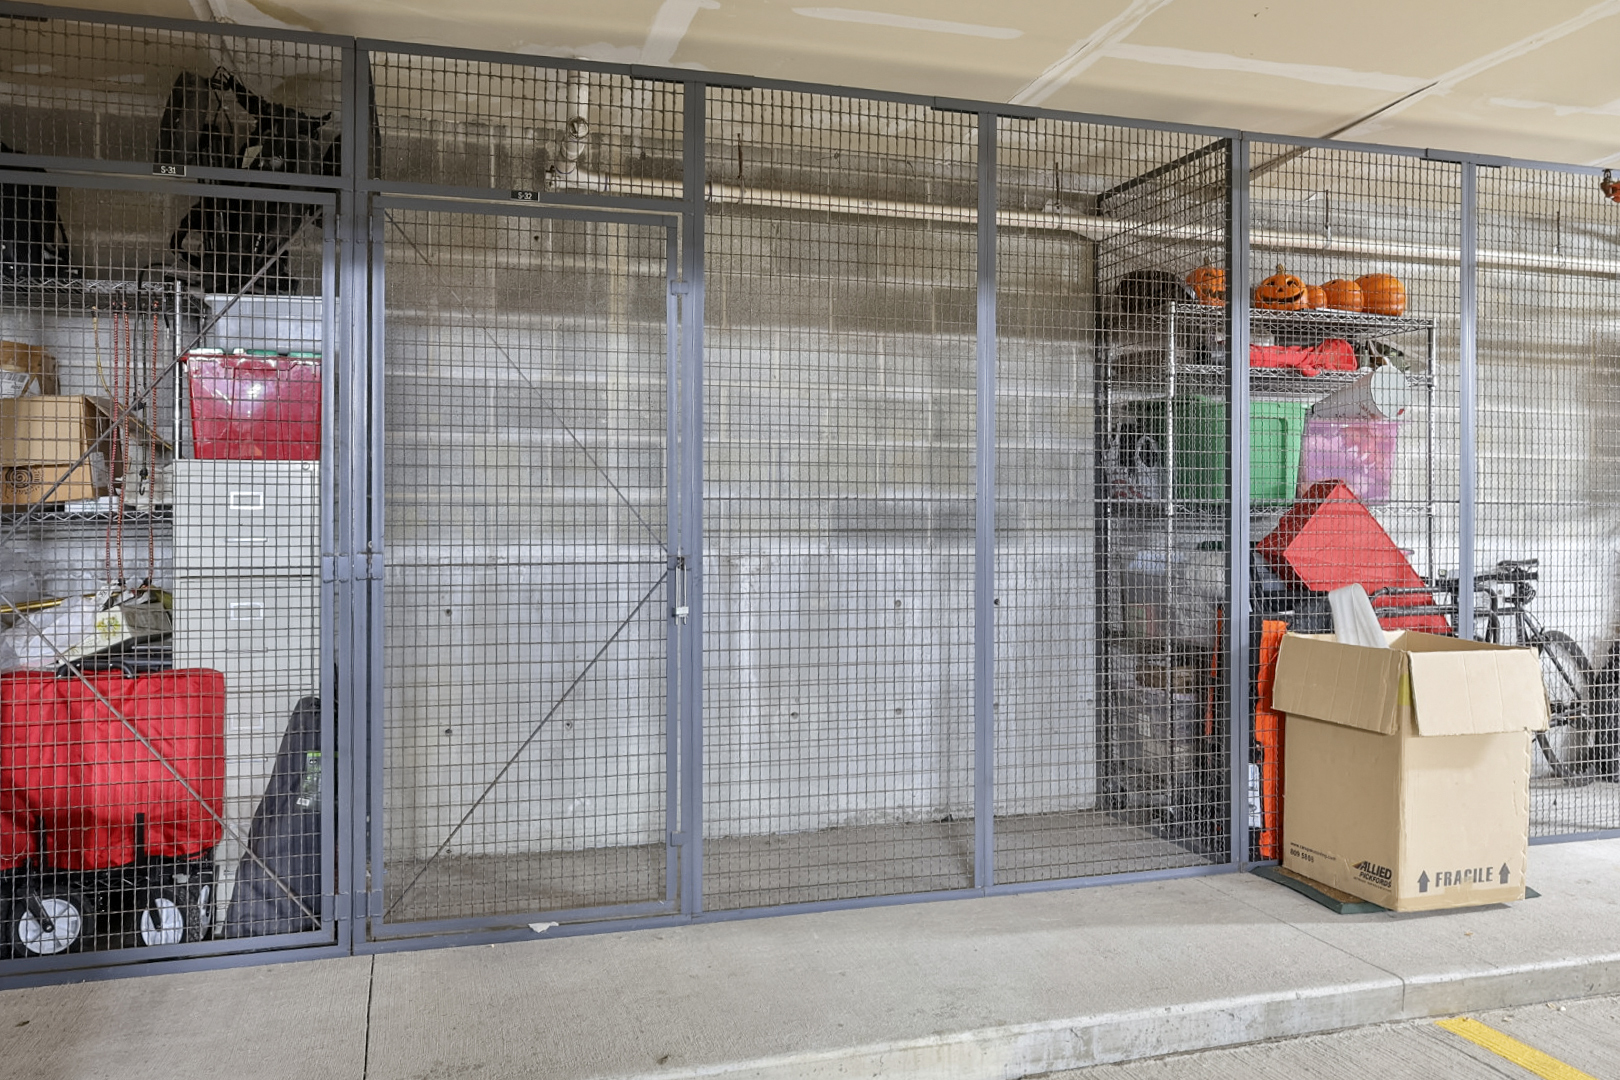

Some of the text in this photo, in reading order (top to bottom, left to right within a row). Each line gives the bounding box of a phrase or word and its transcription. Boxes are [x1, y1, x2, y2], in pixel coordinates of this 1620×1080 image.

[160, 165, 176, 174] S-31
[517, 191, 533, 200] S-32
[1360, 861, 1392, 880] ALLIED
[1435, 867, 1493, 887] FRAGILE
[1359, 871, 1392, 888] PICKFORDS
